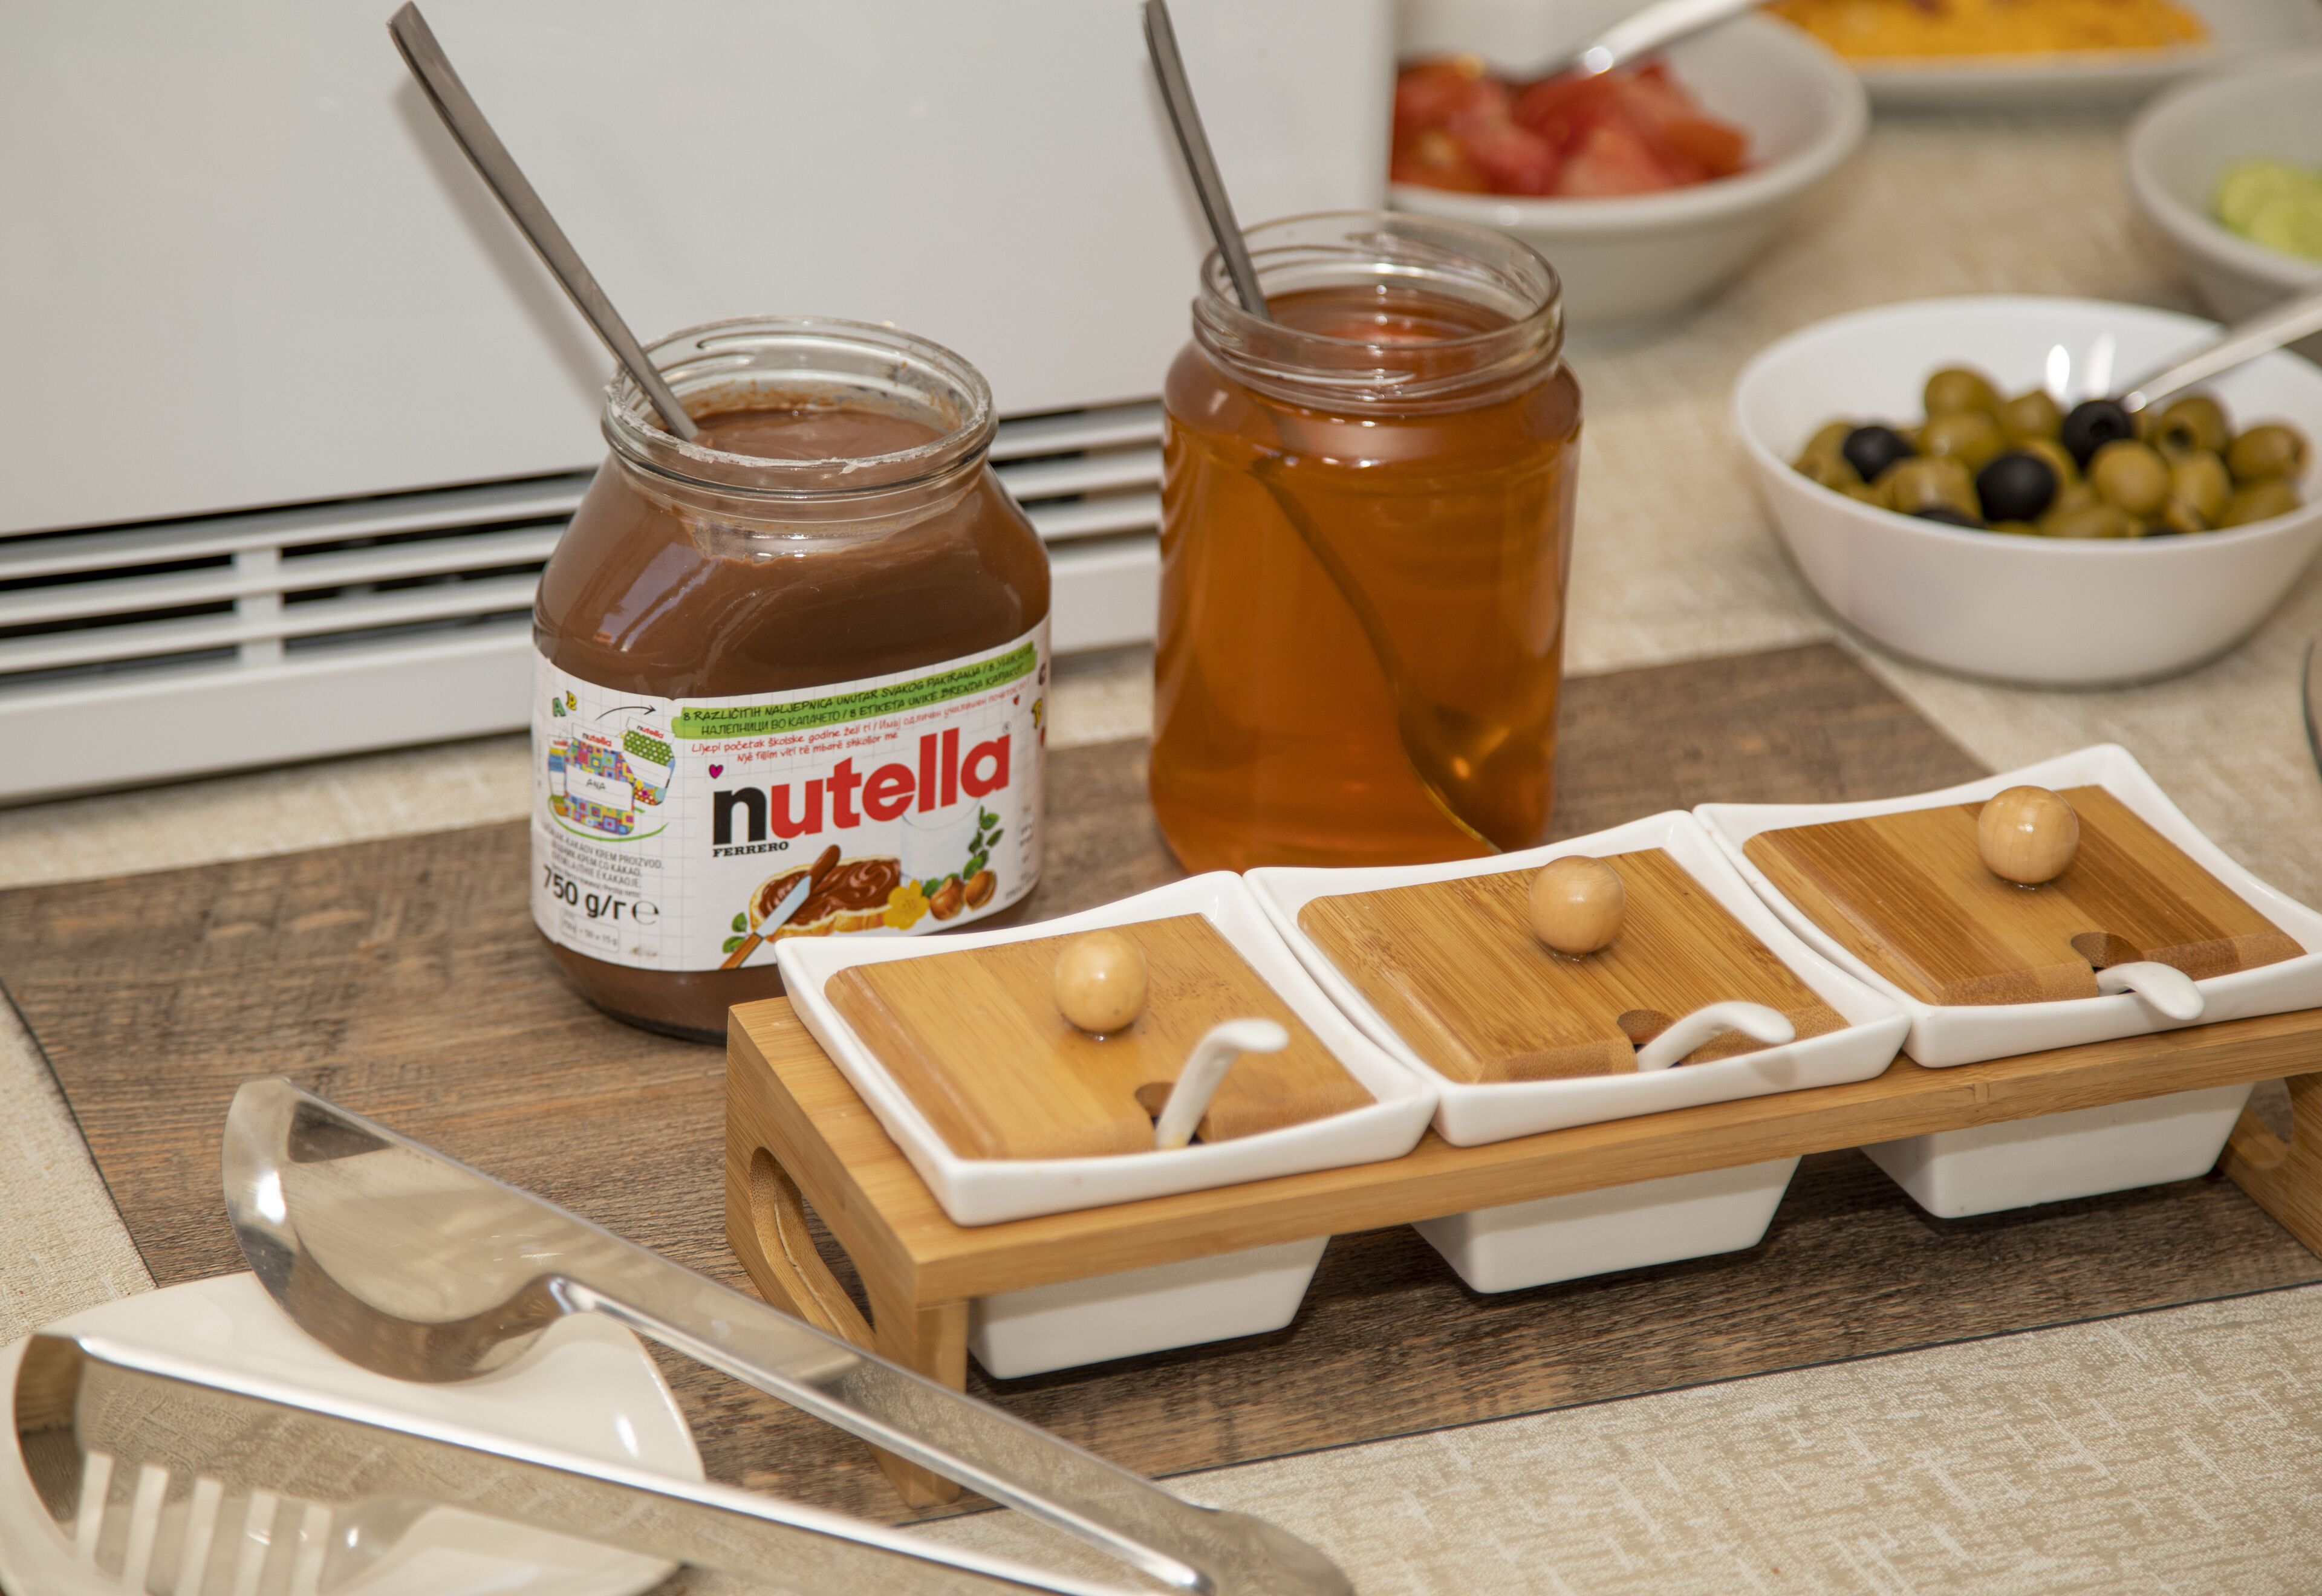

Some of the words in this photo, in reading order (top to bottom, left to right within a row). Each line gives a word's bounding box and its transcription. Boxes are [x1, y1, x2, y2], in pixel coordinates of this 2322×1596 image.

[683, 712, 691, 721] 8
[694, 707, 761, 721] RAZLIČITIH
[765, 699, 832, 715] NALJEPNICA
[837, 690, 878, 705] UNUTAR
[881, 682, 923, 697] SVAKOG
[701, 721, 769, 735] НАЛЕПНИЦИ
[772, 719, 786, 730] ВО
[789, 711, 840, 727] КАПАЧЕТО
[850, 709, 856, 718] 8
[860, 699, 905, 715] ETIKETA
[909, 689, 938, 705] UNIKE
[941, 681, 983, 698] BRENDA
[637, 725, 664, 739] nutella
[692, 742, 721, 755] Lijepi
[724, 739, 765, 753] početak
[768, 735, 804, 747] školske
[808, 730, 841, 744] godine
[844, 725, 860, 736] želi
[813, 741, 843, 751] mbarë
[847, 735, 880, 747] shkollor
[885, 732, 899, 741] me
[587, 779, 605, 790] ANA
[713, 727, 1011, 845] nutella
[713, 842, 790, 858] FERRERO
[544, 864, 577, 906] 750
